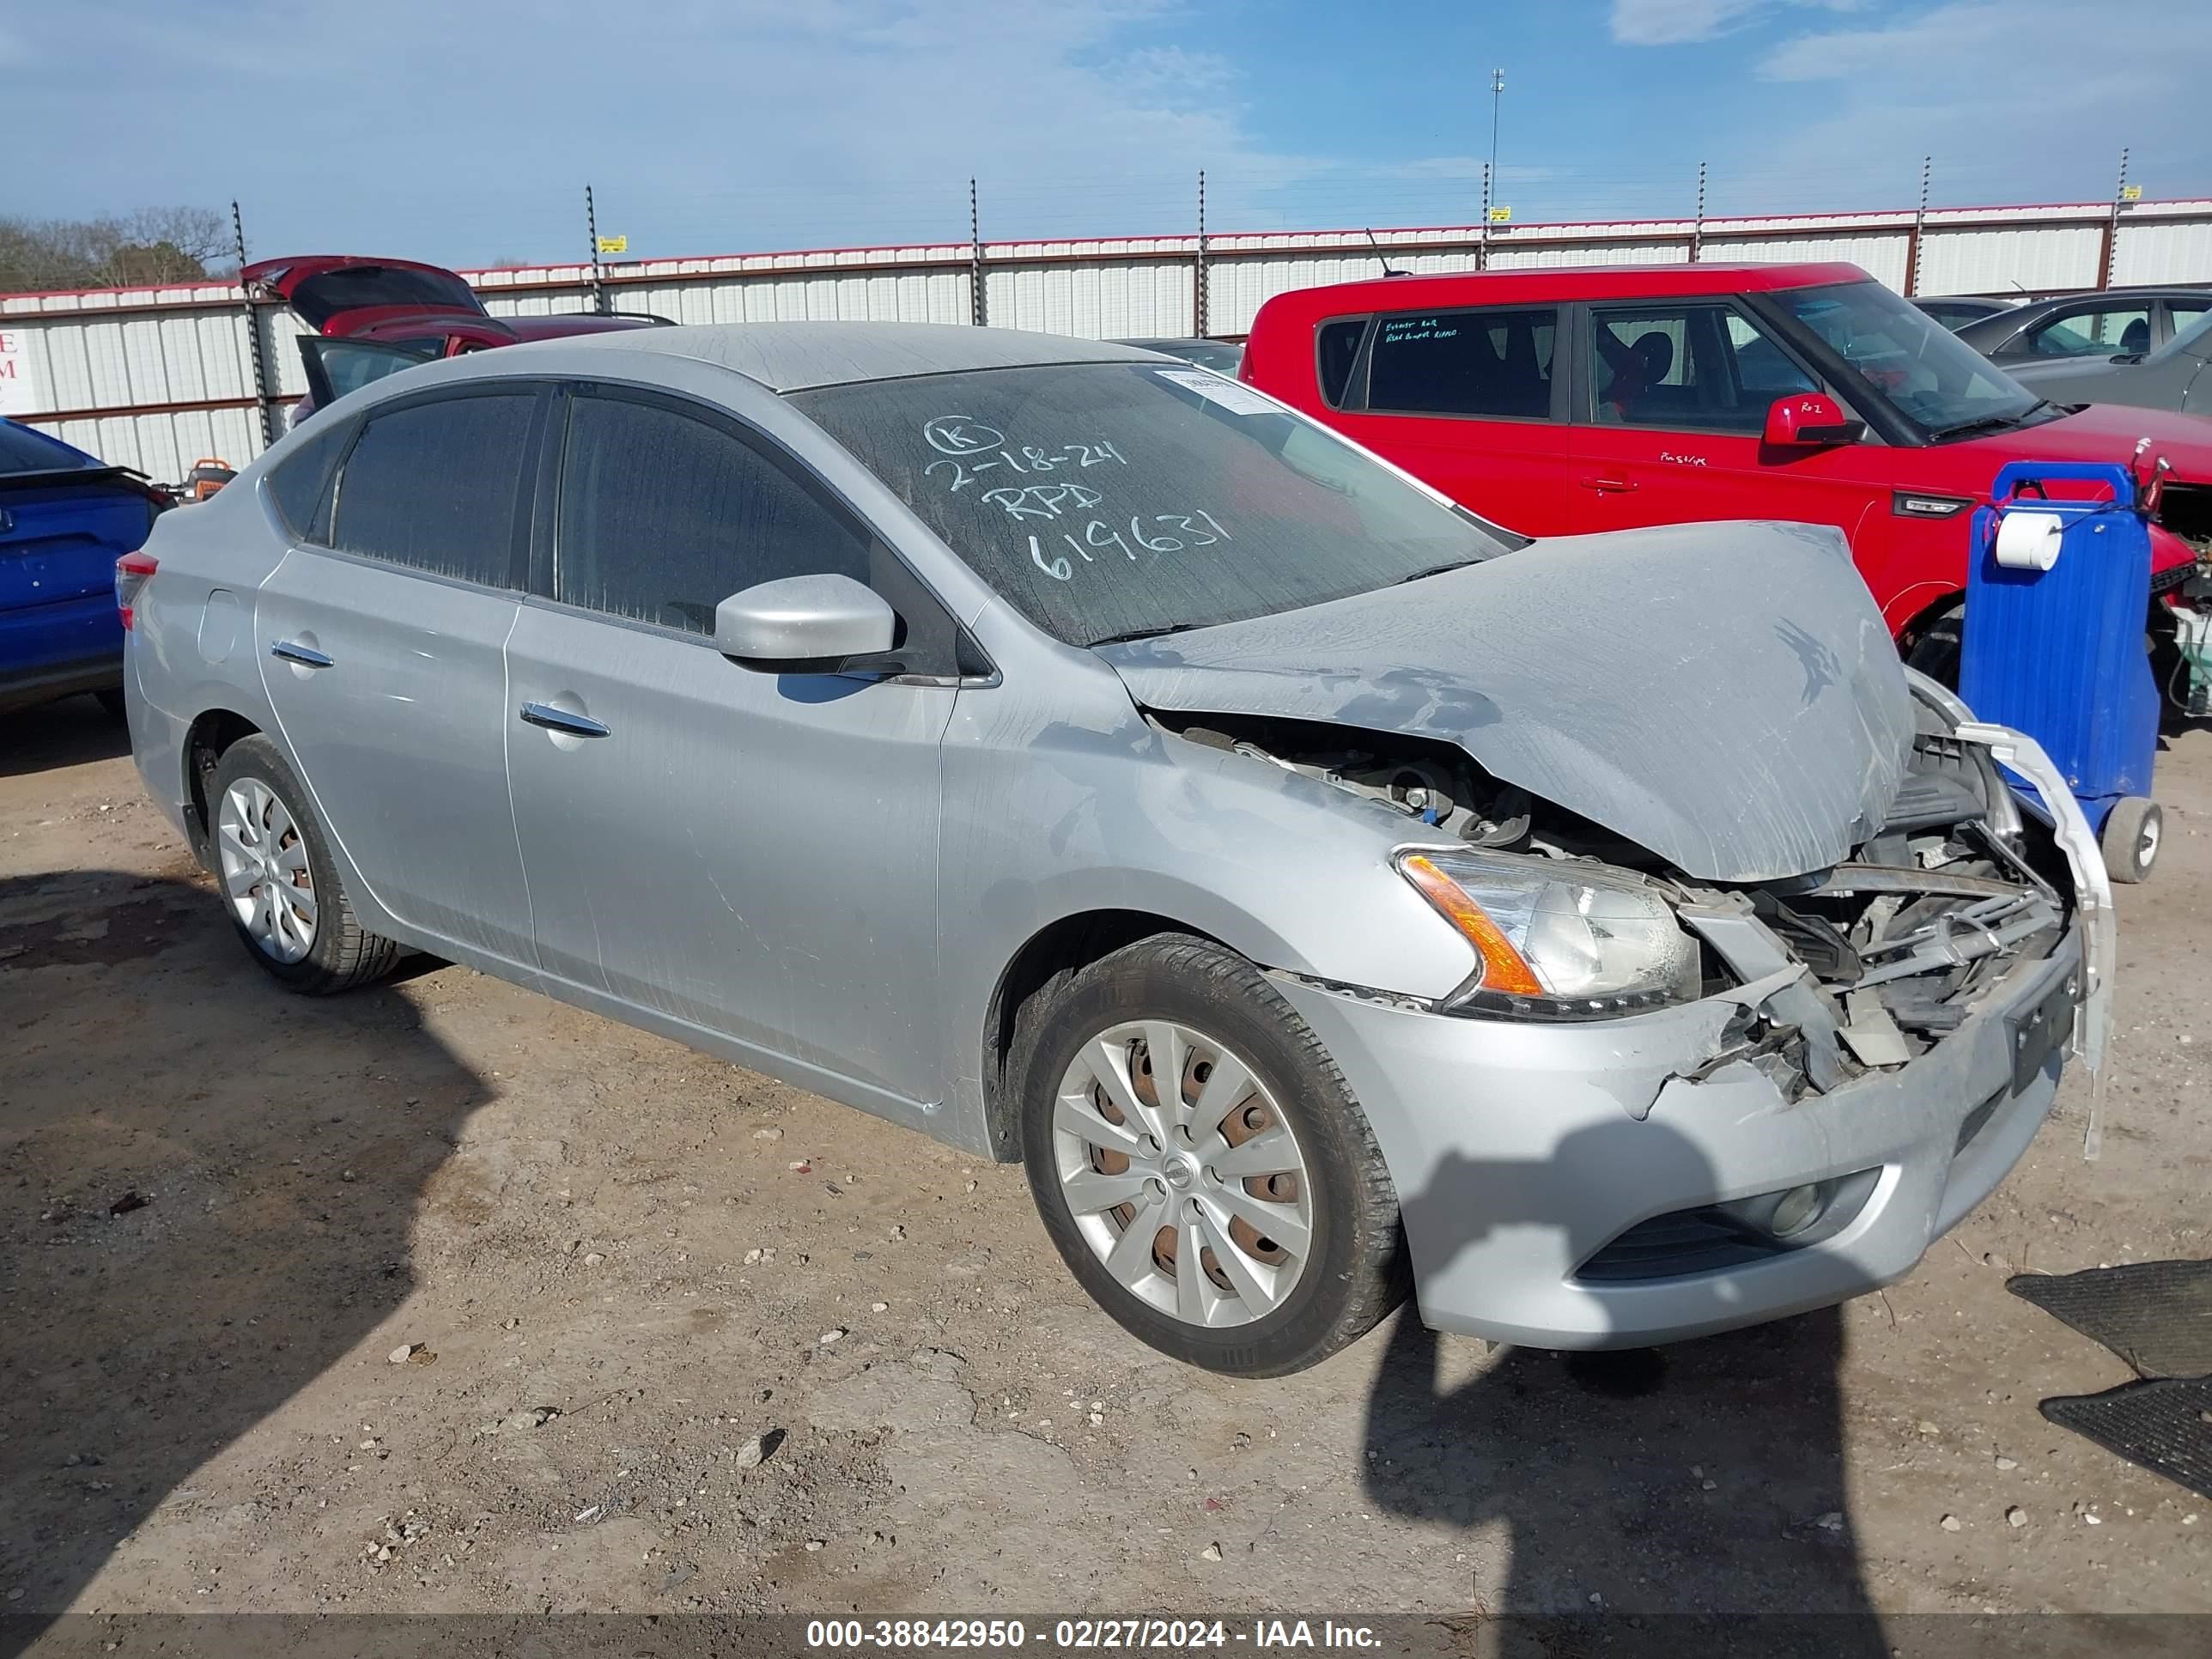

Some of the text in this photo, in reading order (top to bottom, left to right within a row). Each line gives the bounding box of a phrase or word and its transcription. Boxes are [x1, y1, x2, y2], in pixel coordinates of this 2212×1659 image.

[925, 441, 1127, 492] 2-18-24
[981, 483, 1103, 520] RPD
[1028, 509, 1233, 581] 619631
